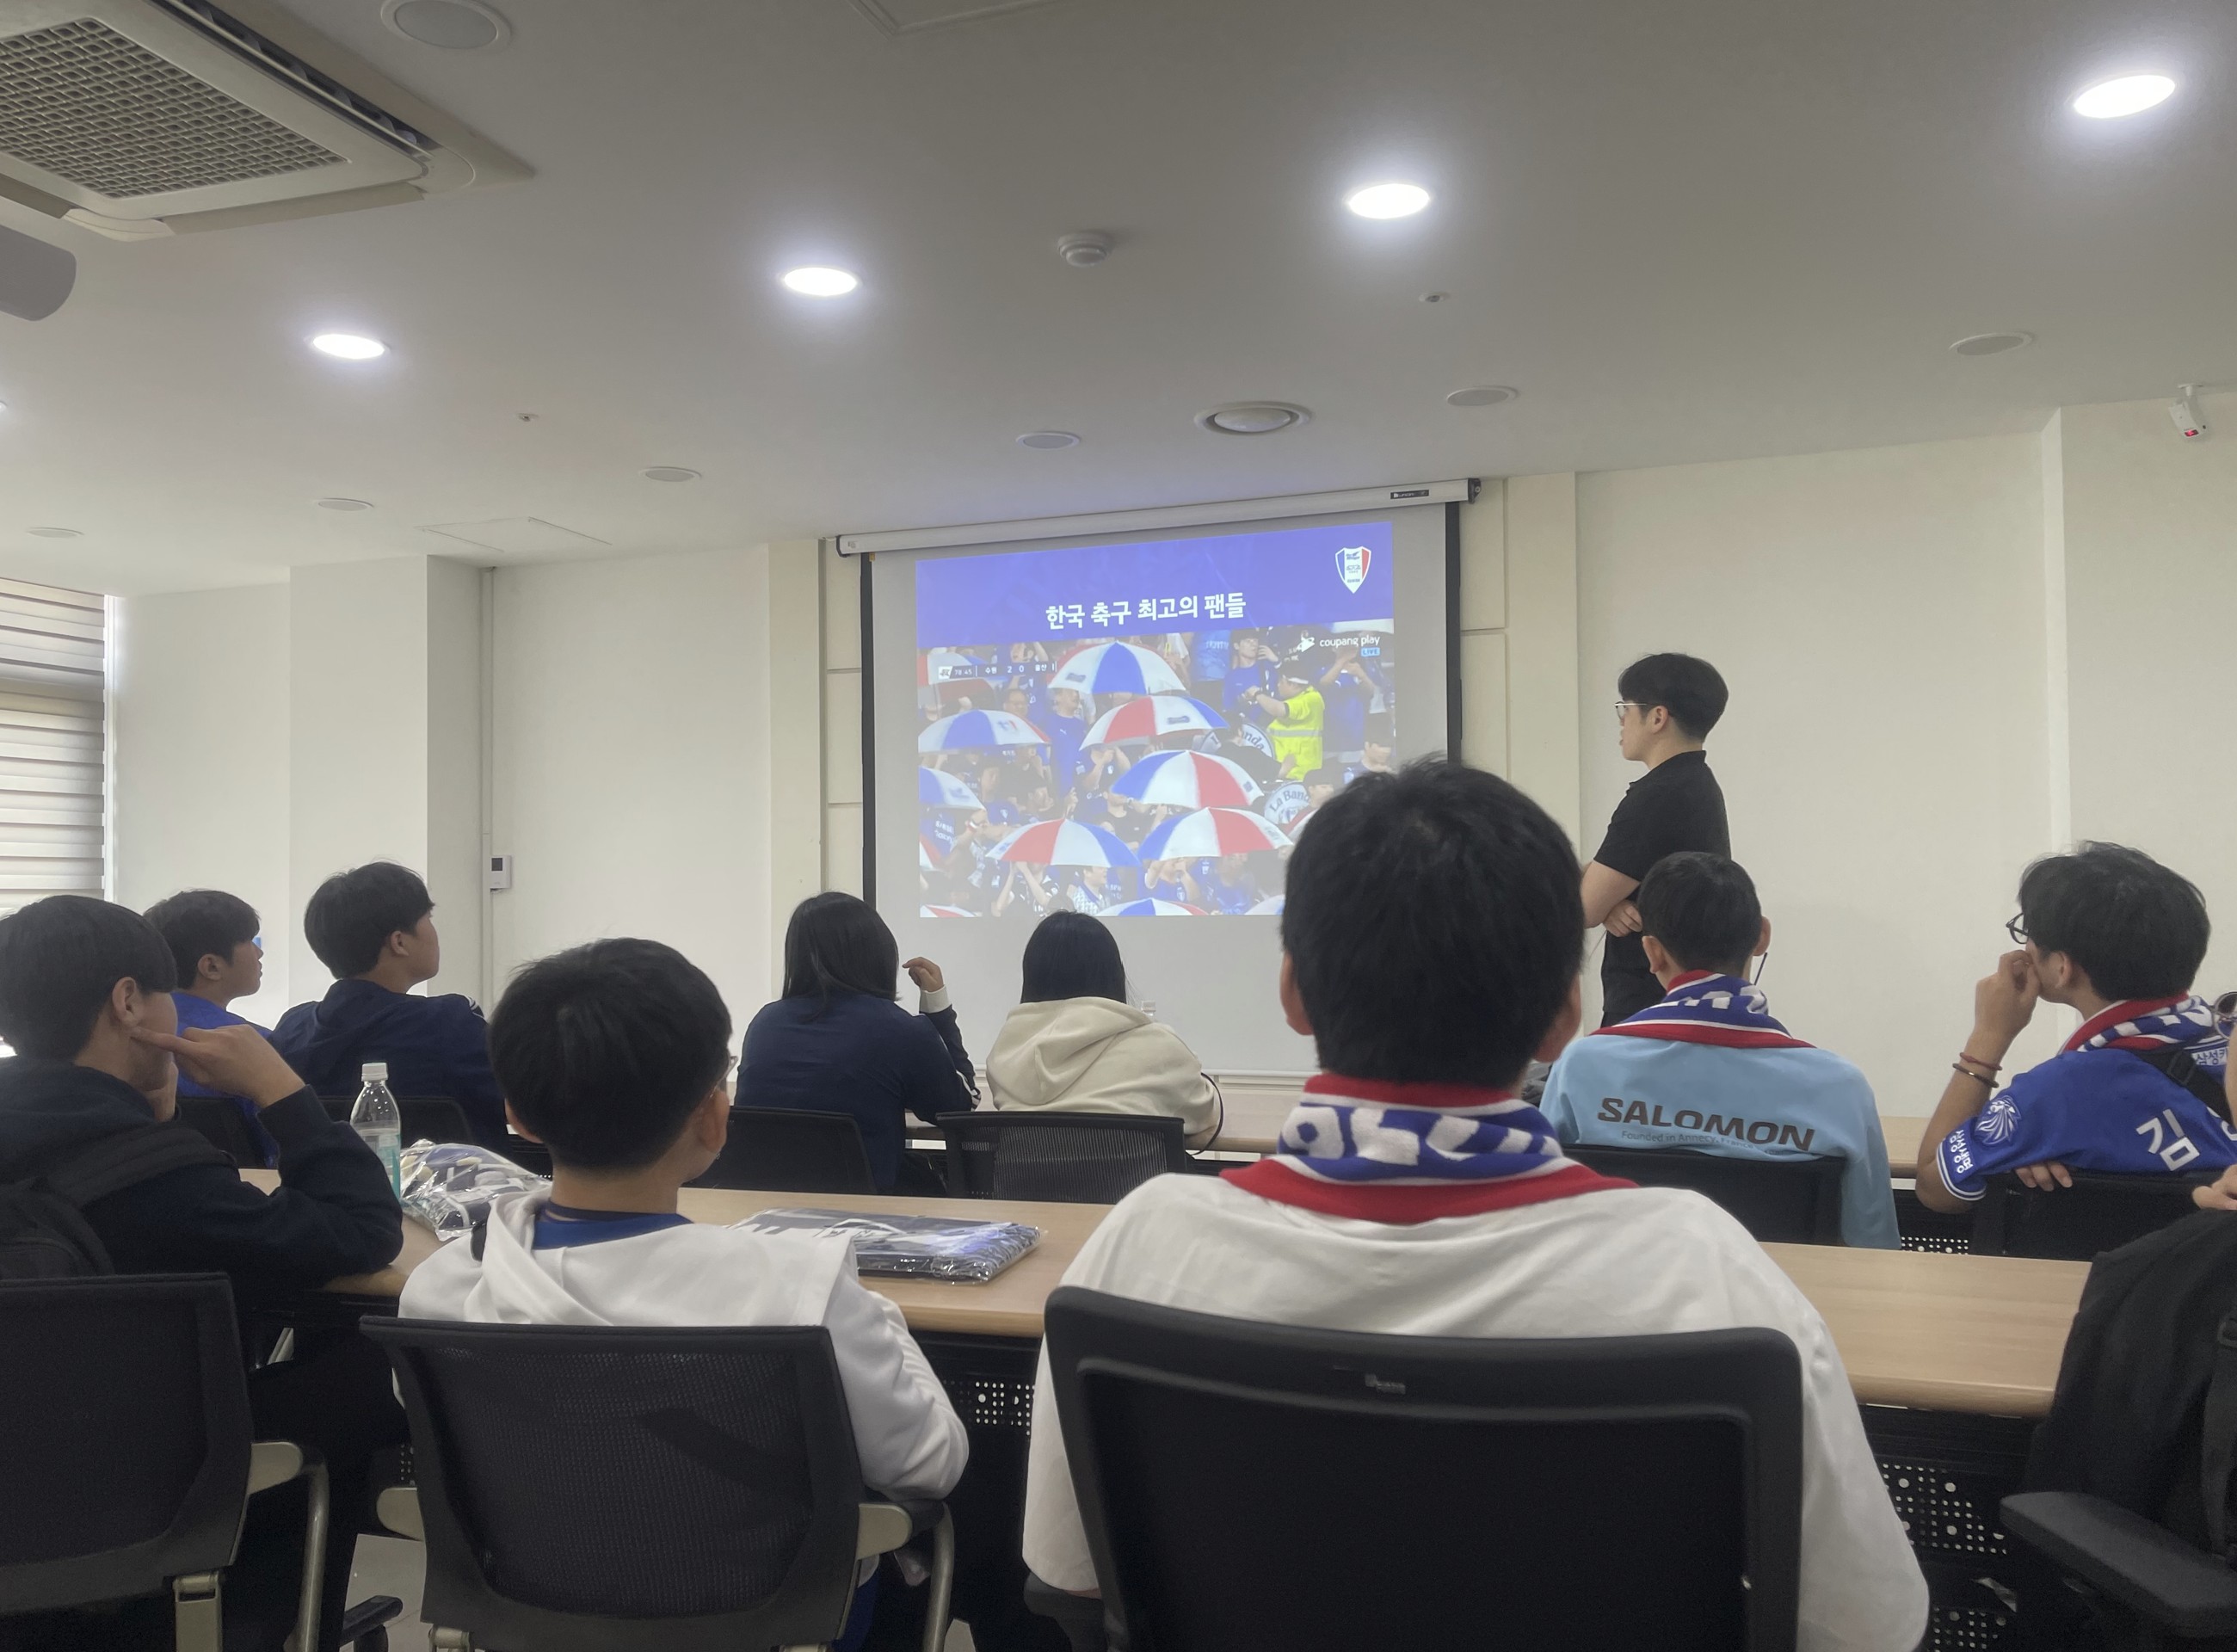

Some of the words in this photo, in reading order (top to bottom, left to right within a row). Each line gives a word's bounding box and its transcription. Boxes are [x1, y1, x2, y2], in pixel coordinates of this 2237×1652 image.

[1045, 604, 1086, 630] 한국
[1090, 601, 1132, 627] 축구
[1137, 595, 1199, 621] 최고의
[1204, 592, 1247, 620] 팬들
[1319, 637, 1359, 649] coupang
[1360, 634, 1381, 647] play
[1597, 1097, 1815, 1151] SALOMON
[1621, 1130, 1664, 1143] Founded
[1666, 1132, 1676, 1143] in
[2135, 1108, 2200, 1172] 김
[1949, 1129, 1975, 1174] 삼성생명
